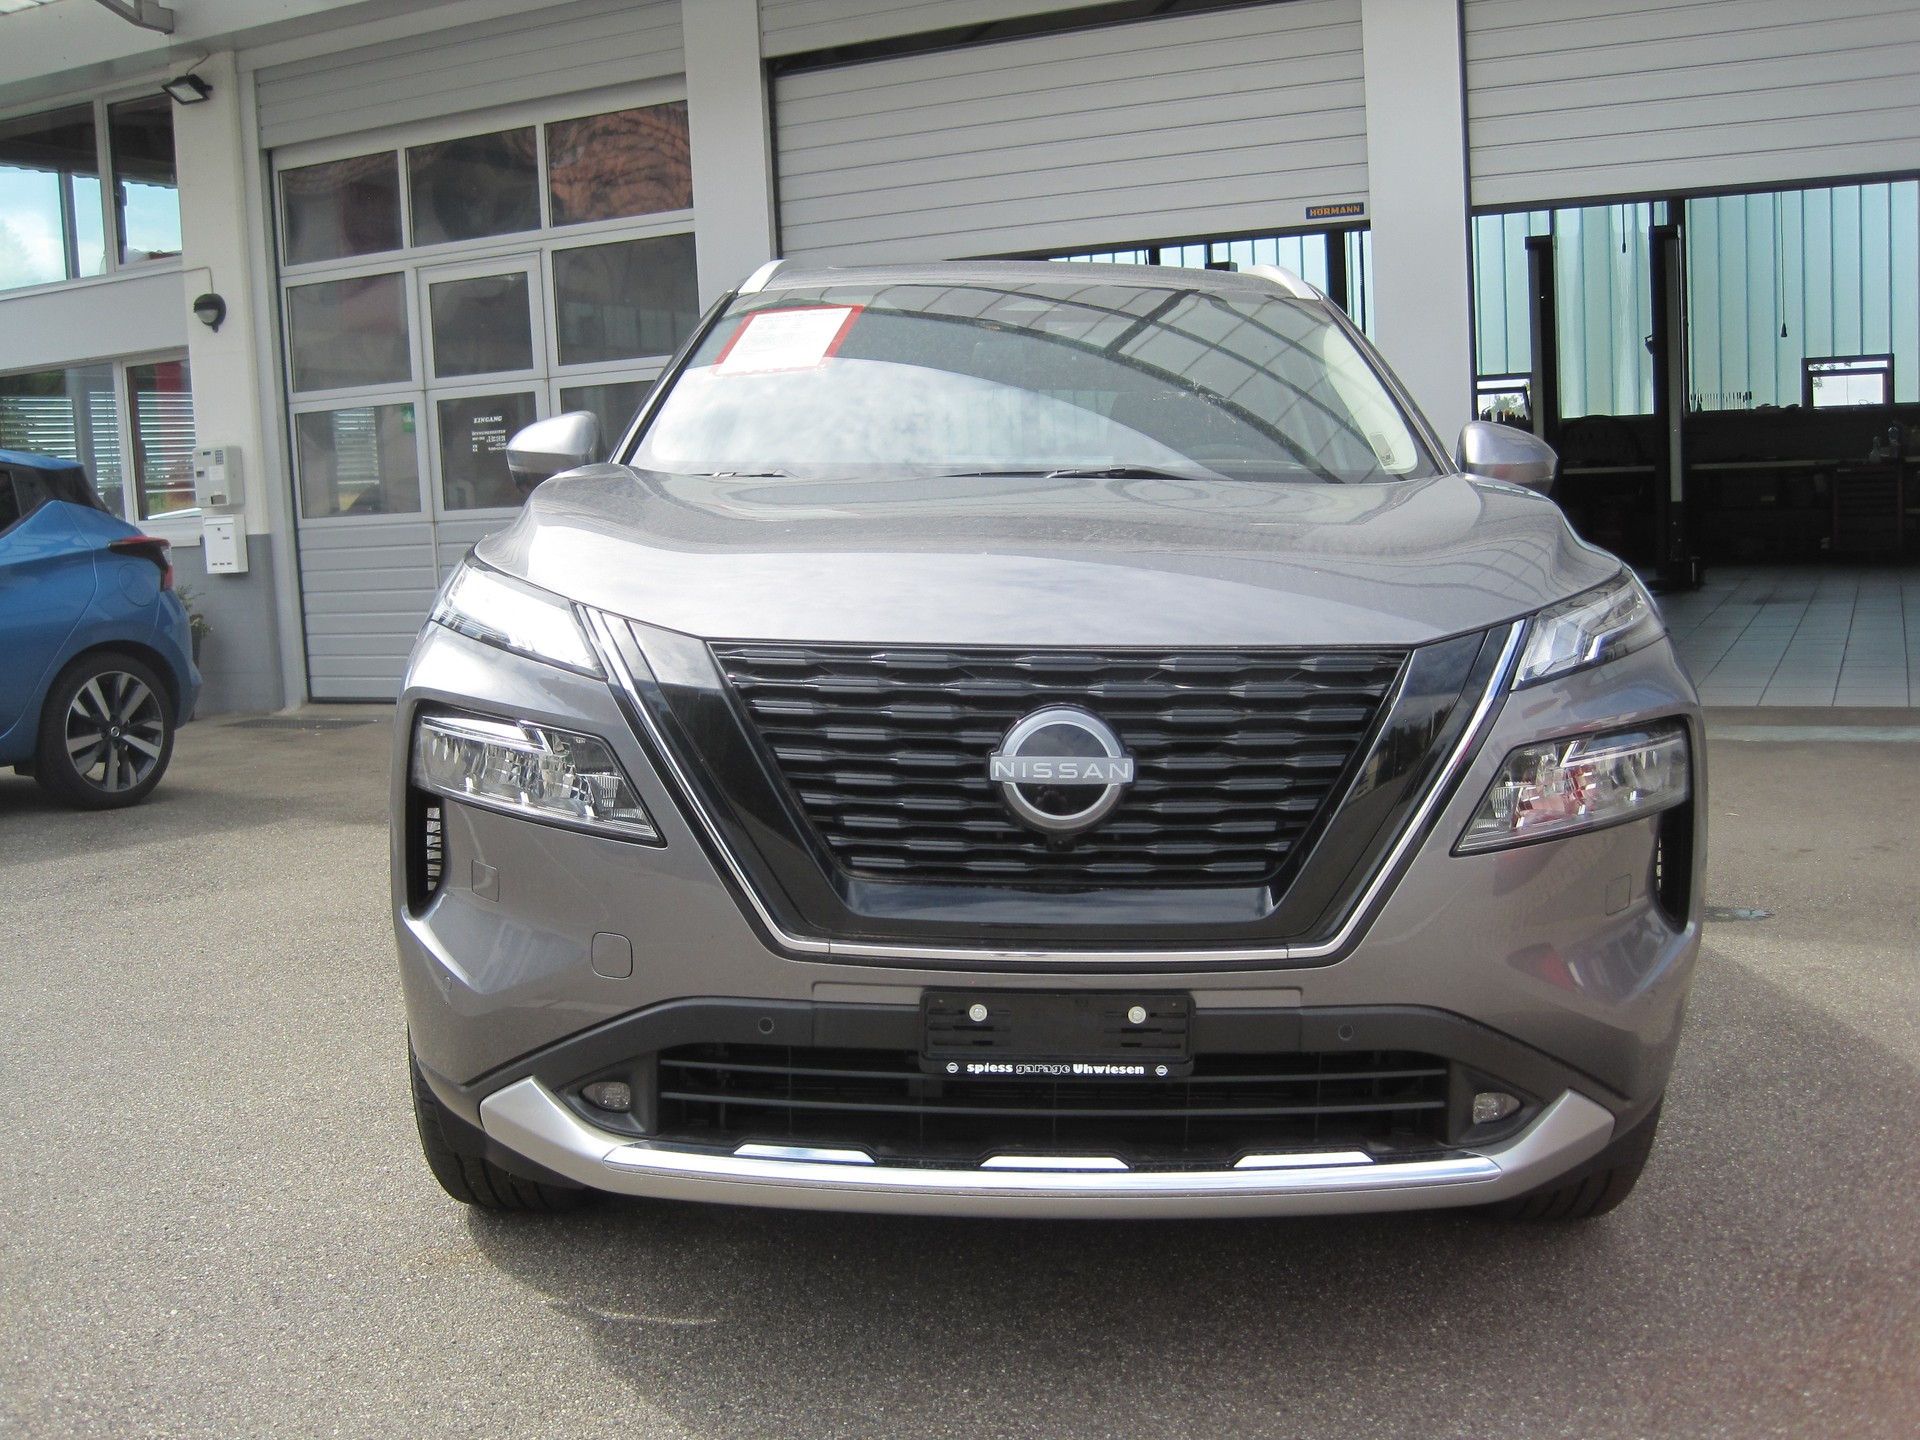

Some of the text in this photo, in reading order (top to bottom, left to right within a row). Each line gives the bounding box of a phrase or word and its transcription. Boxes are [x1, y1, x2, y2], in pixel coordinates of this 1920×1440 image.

[473, 415, 503, 424] EINGANG
[995, 761, 1129, 779] NISSAN
[966, 1062, 1145, 1075] spiess garage Uhwiesen
